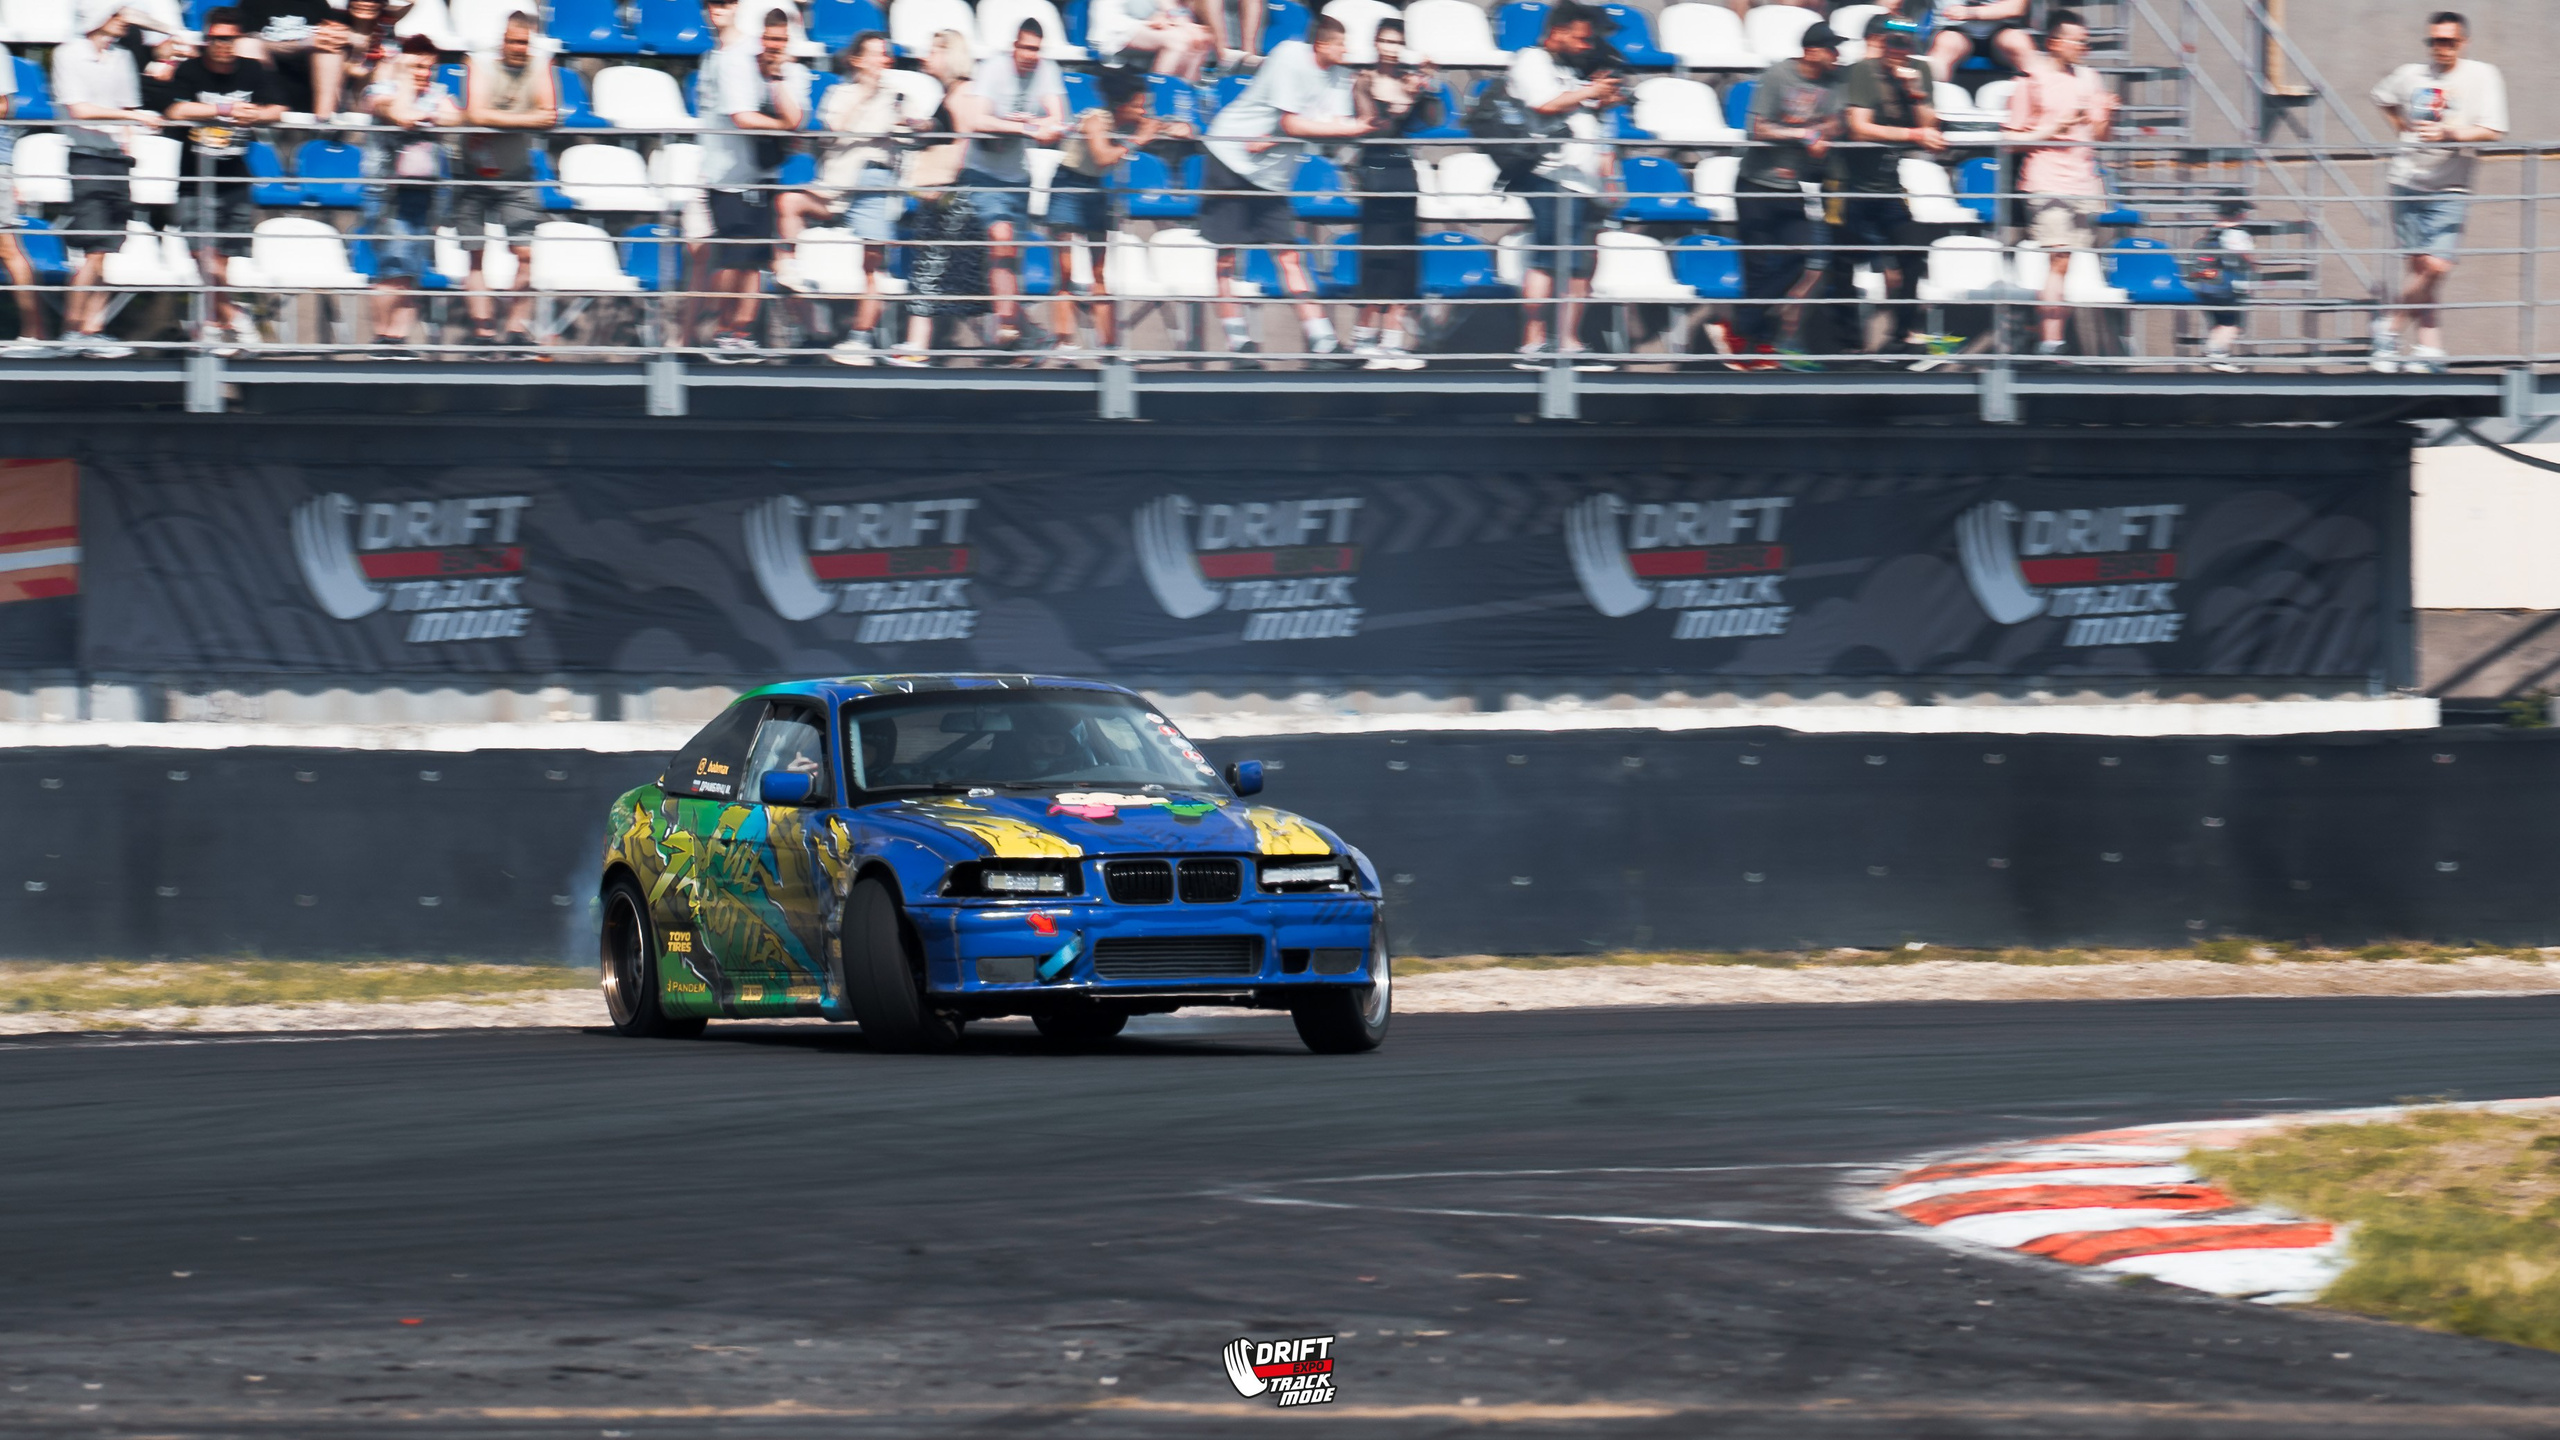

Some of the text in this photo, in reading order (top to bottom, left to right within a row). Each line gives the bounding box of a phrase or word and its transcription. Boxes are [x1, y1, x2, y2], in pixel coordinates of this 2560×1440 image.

[358, 496, 534, 550] DRIFT
[809, 498, 979, 551] DRIFT
[1196, 498, 1366, 550] DRIFT
[1627, 496, 1794, 549] DRIFT
[2019, 504, 2186, 556] DRIFT
[667, 941, 692, 953] TIRES
[669, 931, 692, 942] TOYO
